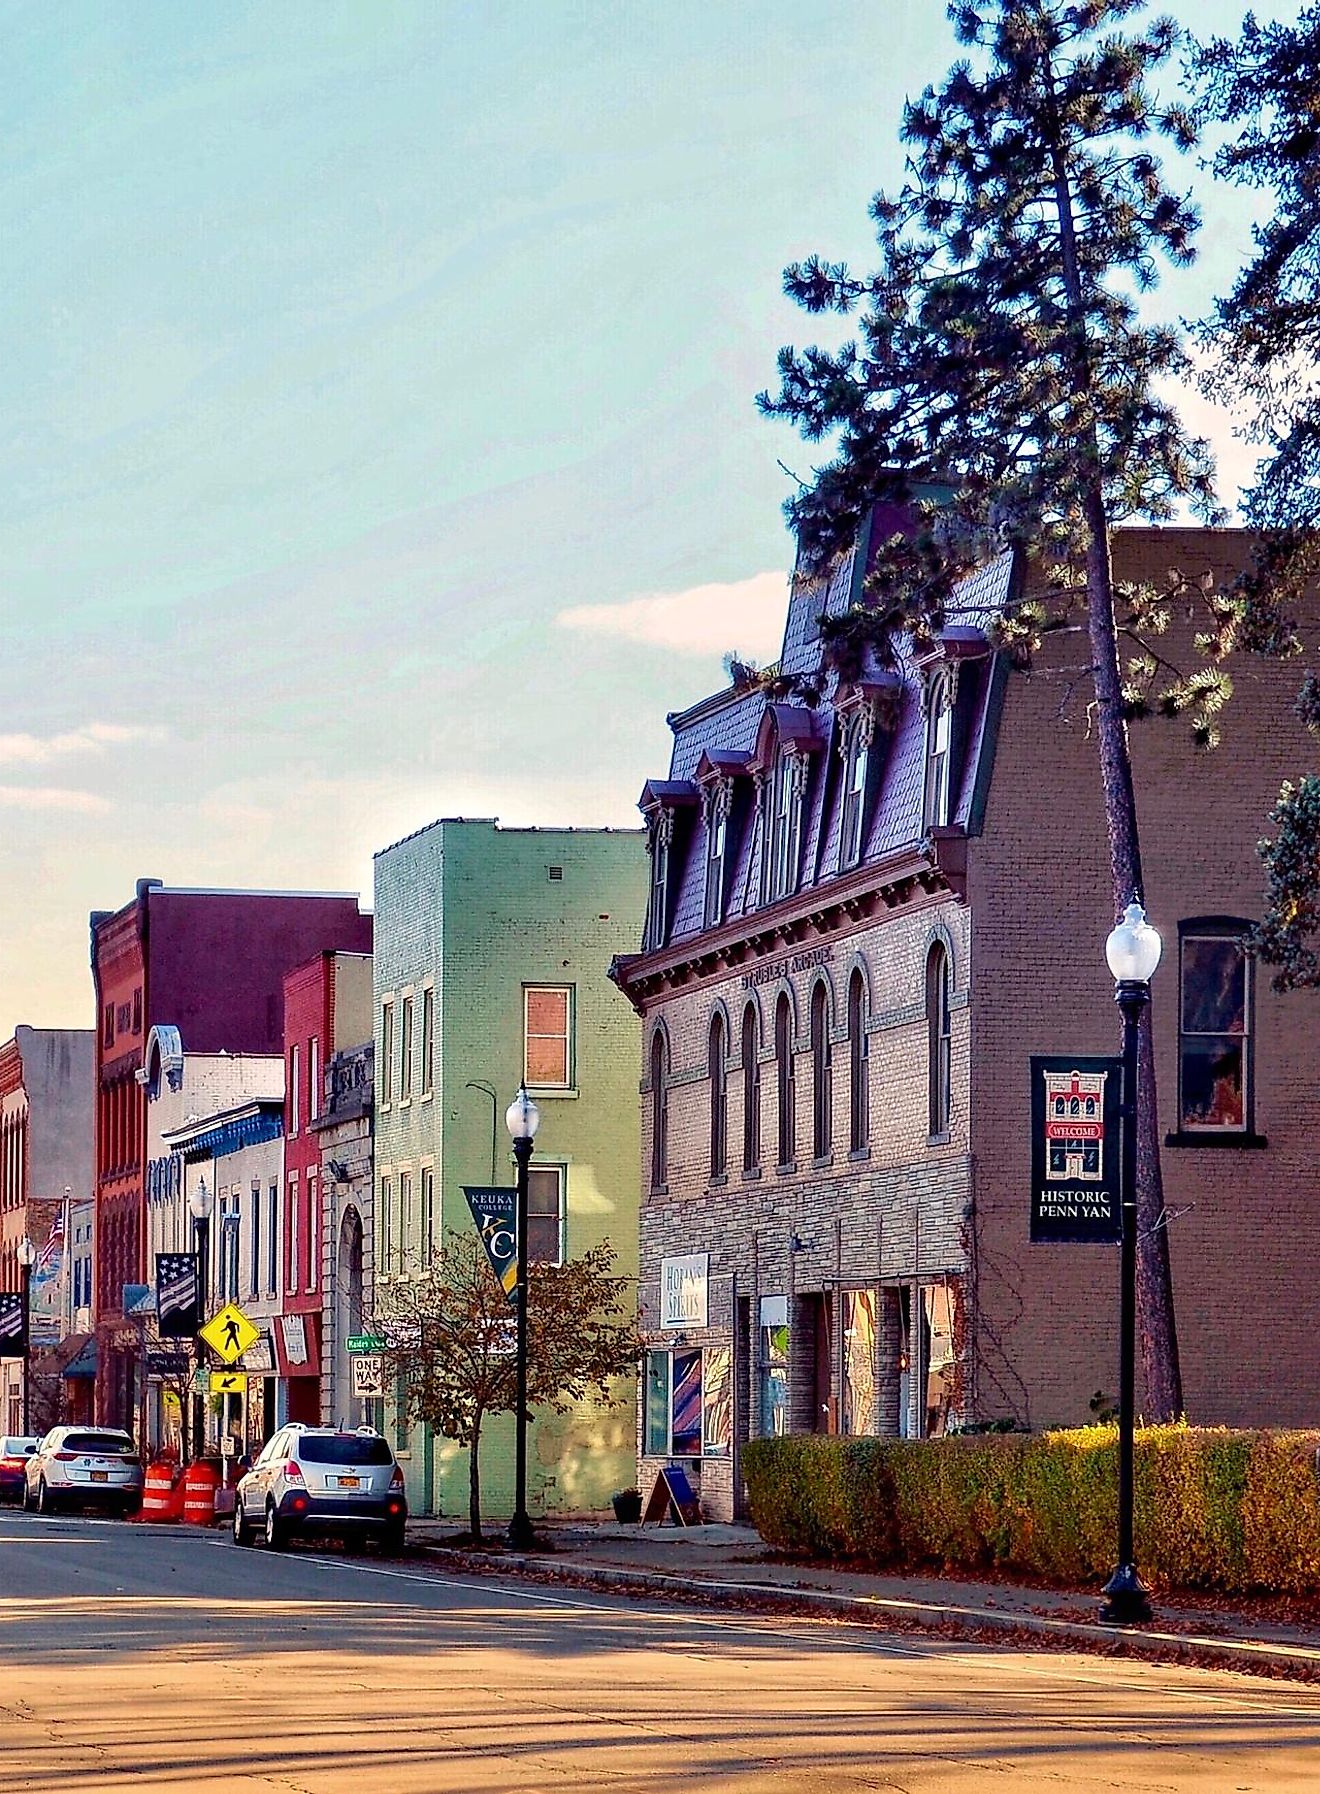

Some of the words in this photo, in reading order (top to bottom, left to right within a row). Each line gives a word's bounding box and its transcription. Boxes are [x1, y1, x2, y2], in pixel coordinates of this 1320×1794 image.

[1052, 1126, 1097, 1136] WELCOME
[471, 1195, 513, 1204] KEUKA
[1041, 1190, 1111, 1203] HISTORIC
[1039, 1205, 1078, 1218] PENN
[1082, 1206, 1112, 1218] YAN
[356, 1361, 379, 1369] ONE
[356, 1371, 380, 1380] WAY
